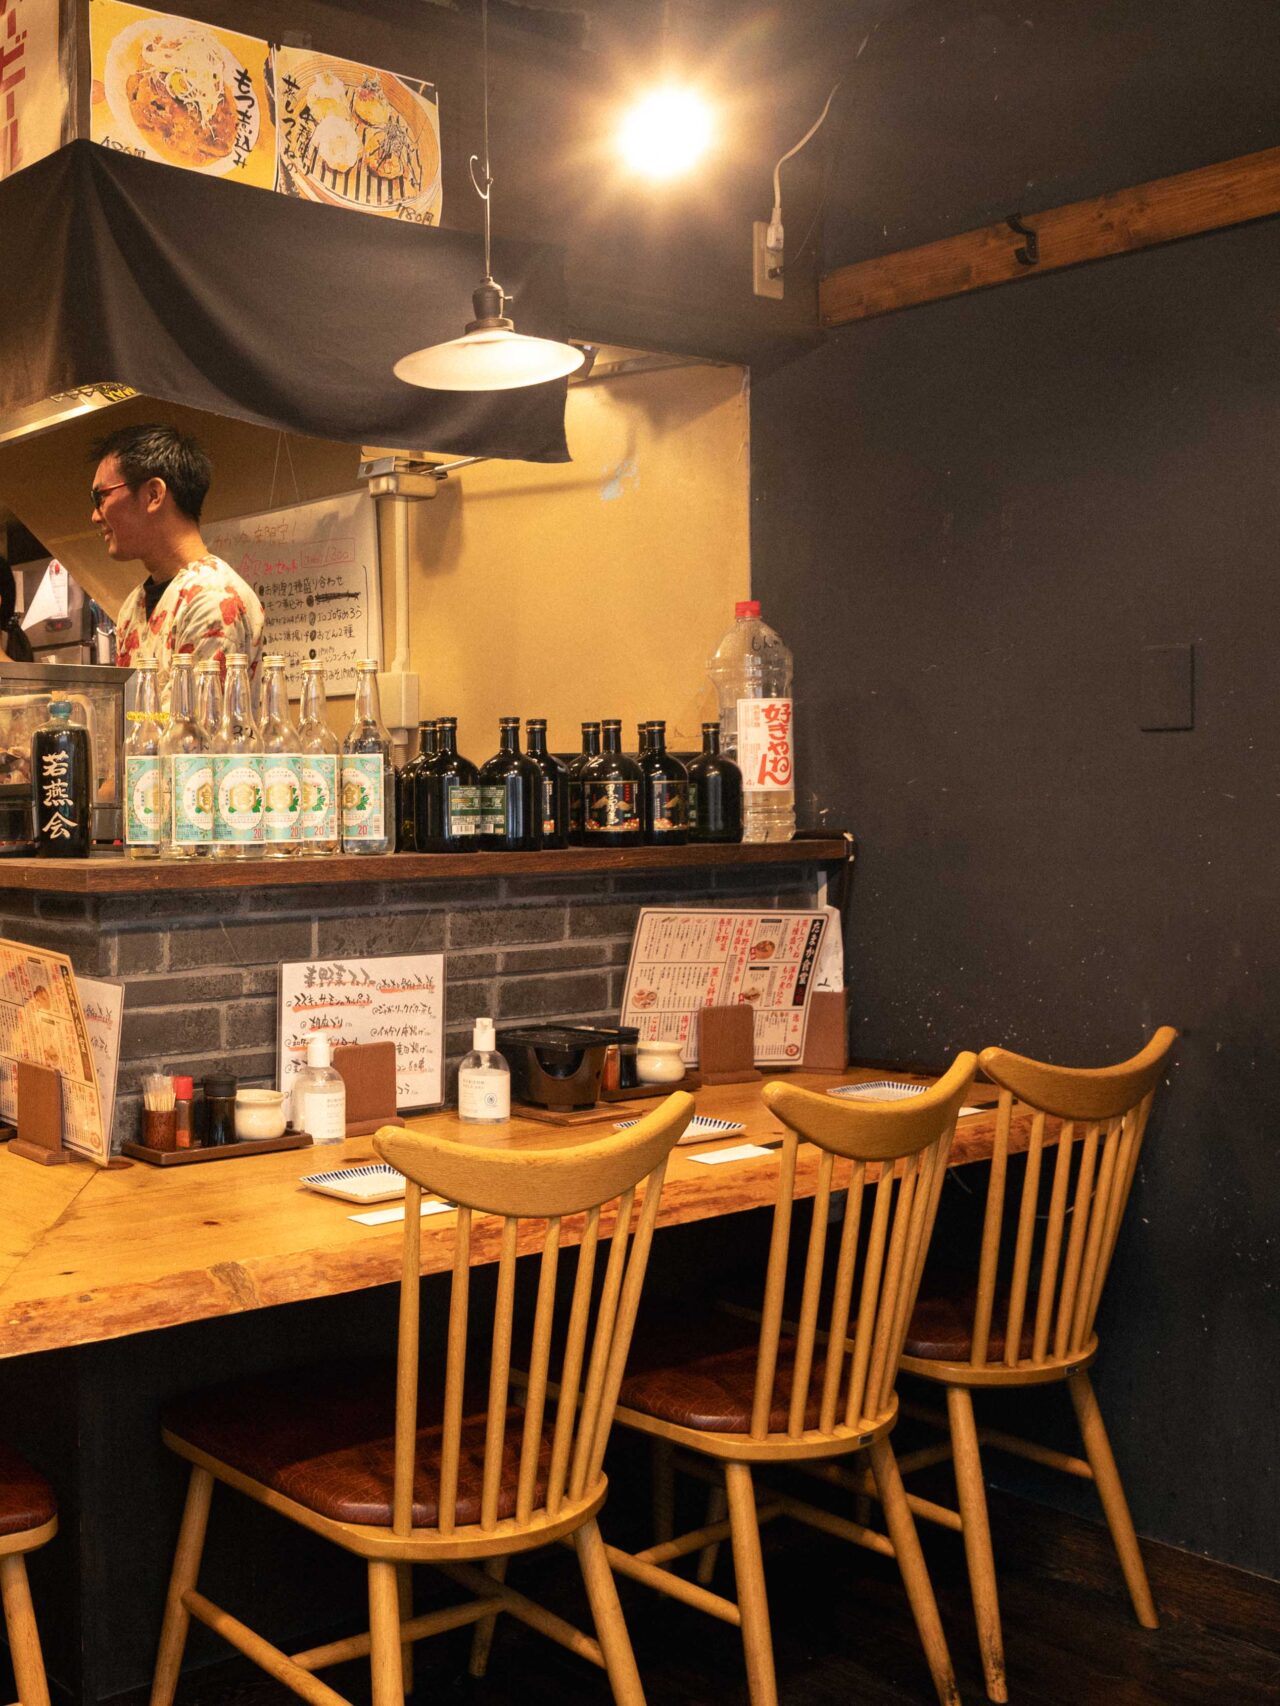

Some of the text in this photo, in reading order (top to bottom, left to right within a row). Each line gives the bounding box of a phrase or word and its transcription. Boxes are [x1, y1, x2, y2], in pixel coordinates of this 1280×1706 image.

[233, 68, 255, 169] もつ煮込み
[281, 75, 301, 174] 蒸しつくねの
[758, 703, 792, 786] 好きやねん
[42, 750, 78, 839] 若燕会
